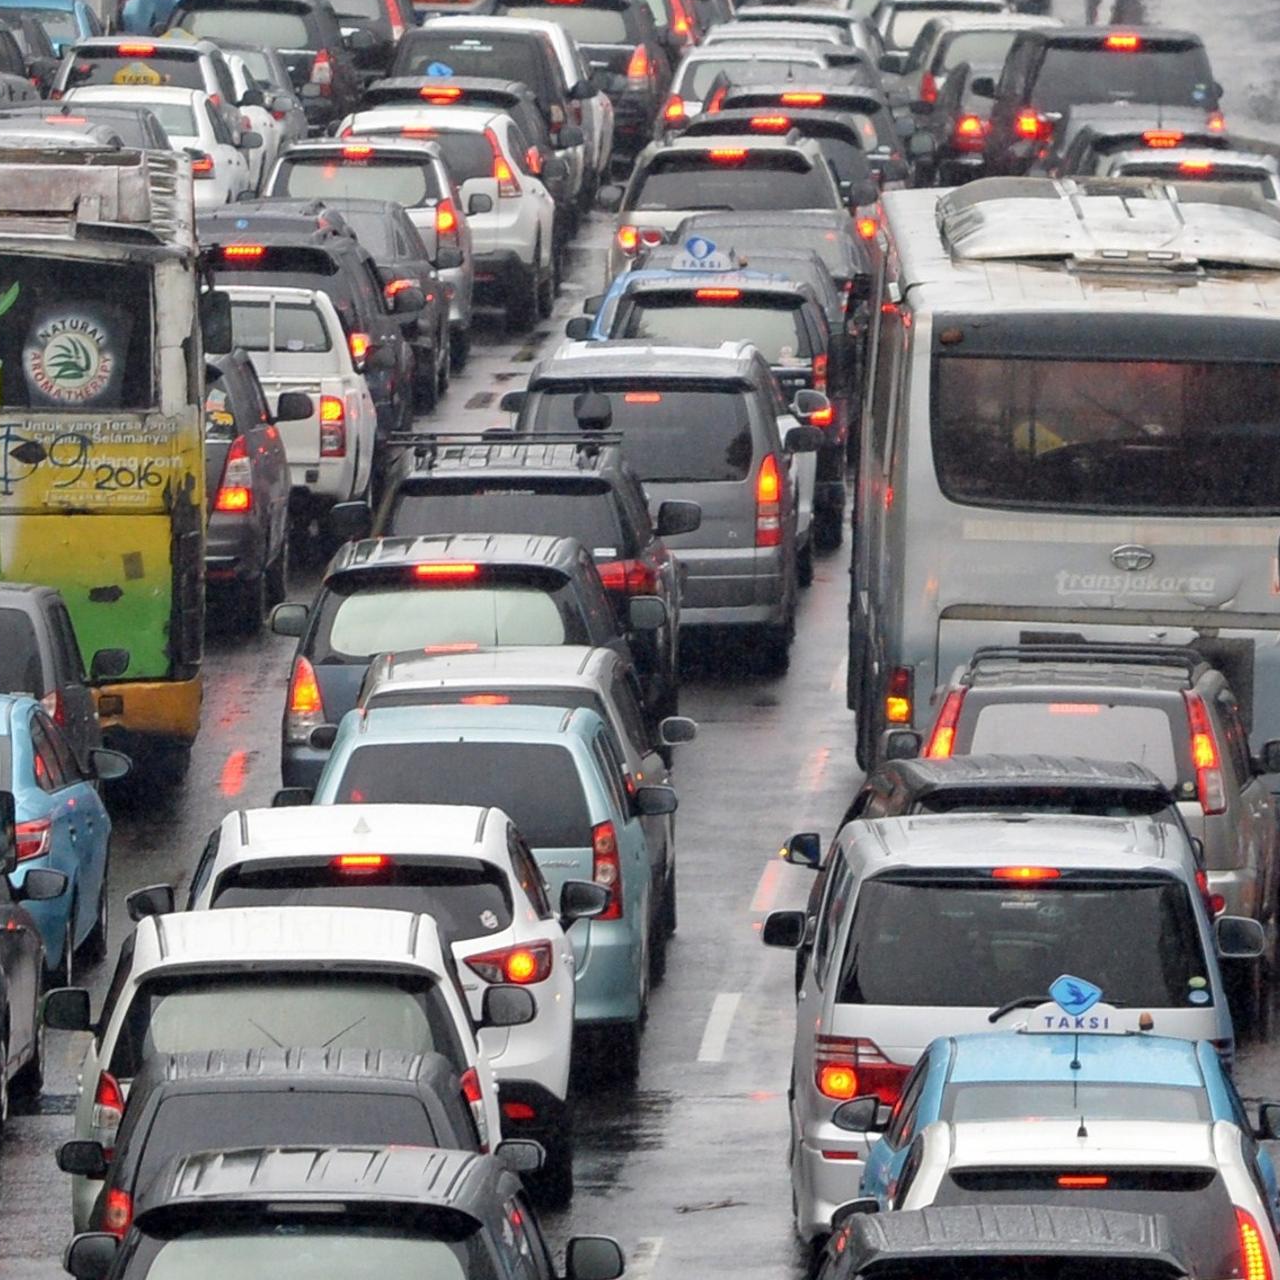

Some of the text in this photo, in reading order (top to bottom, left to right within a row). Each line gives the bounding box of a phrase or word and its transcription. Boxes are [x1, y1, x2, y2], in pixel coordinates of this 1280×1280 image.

[682, 260, 721, 268] TAKSI
[39, 319, 105, 344] NATURAL
[23, 421, 64, 432] Untuk
[68, 423, 102, 436] yang
[92, 433, 169, 446] Selamanya
[96, 461, 163, 490] 2016
[1044, 1016, 1110, 1029] TAKSI
